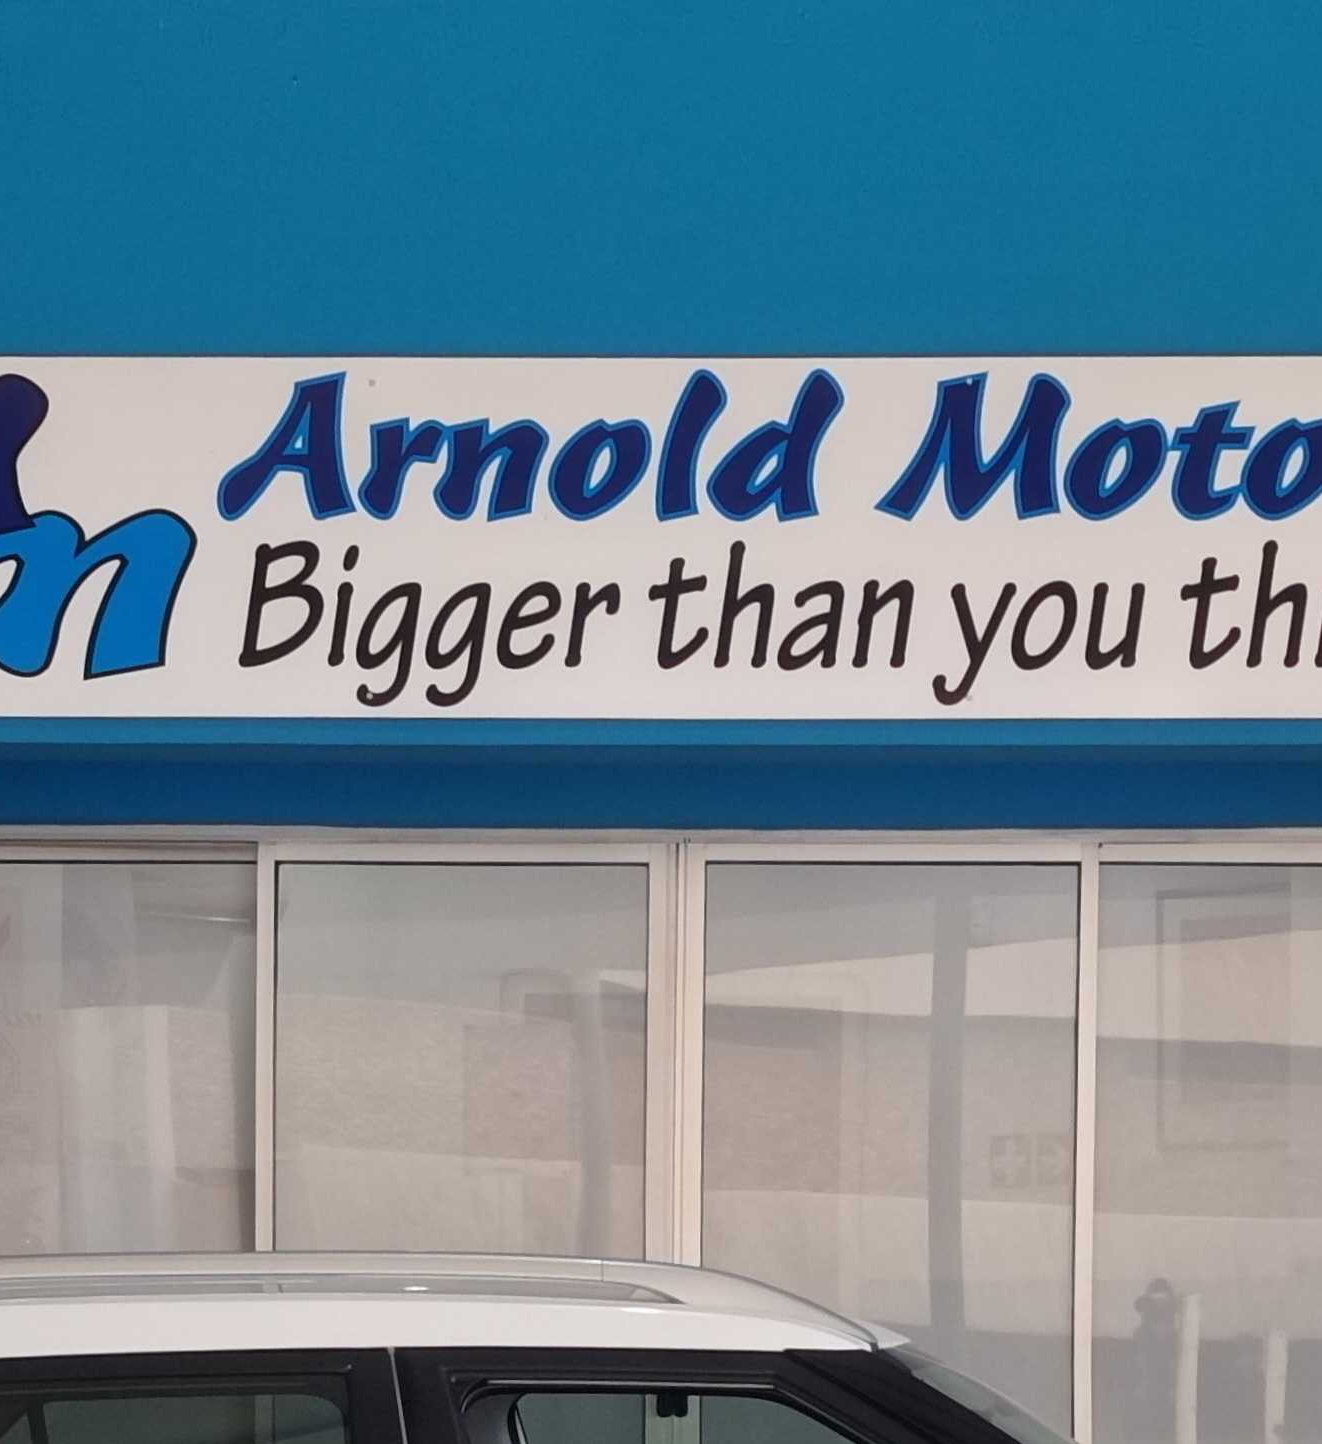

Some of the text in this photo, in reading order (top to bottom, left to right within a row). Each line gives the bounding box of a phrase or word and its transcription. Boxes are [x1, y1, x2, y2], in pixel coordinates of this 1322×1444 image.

[217, 367, 844, 523] Arnold
[237, 540, 620, 708] Bigger
[648, 540, 914, 671] than
[932, 581, 1146, 707] you
